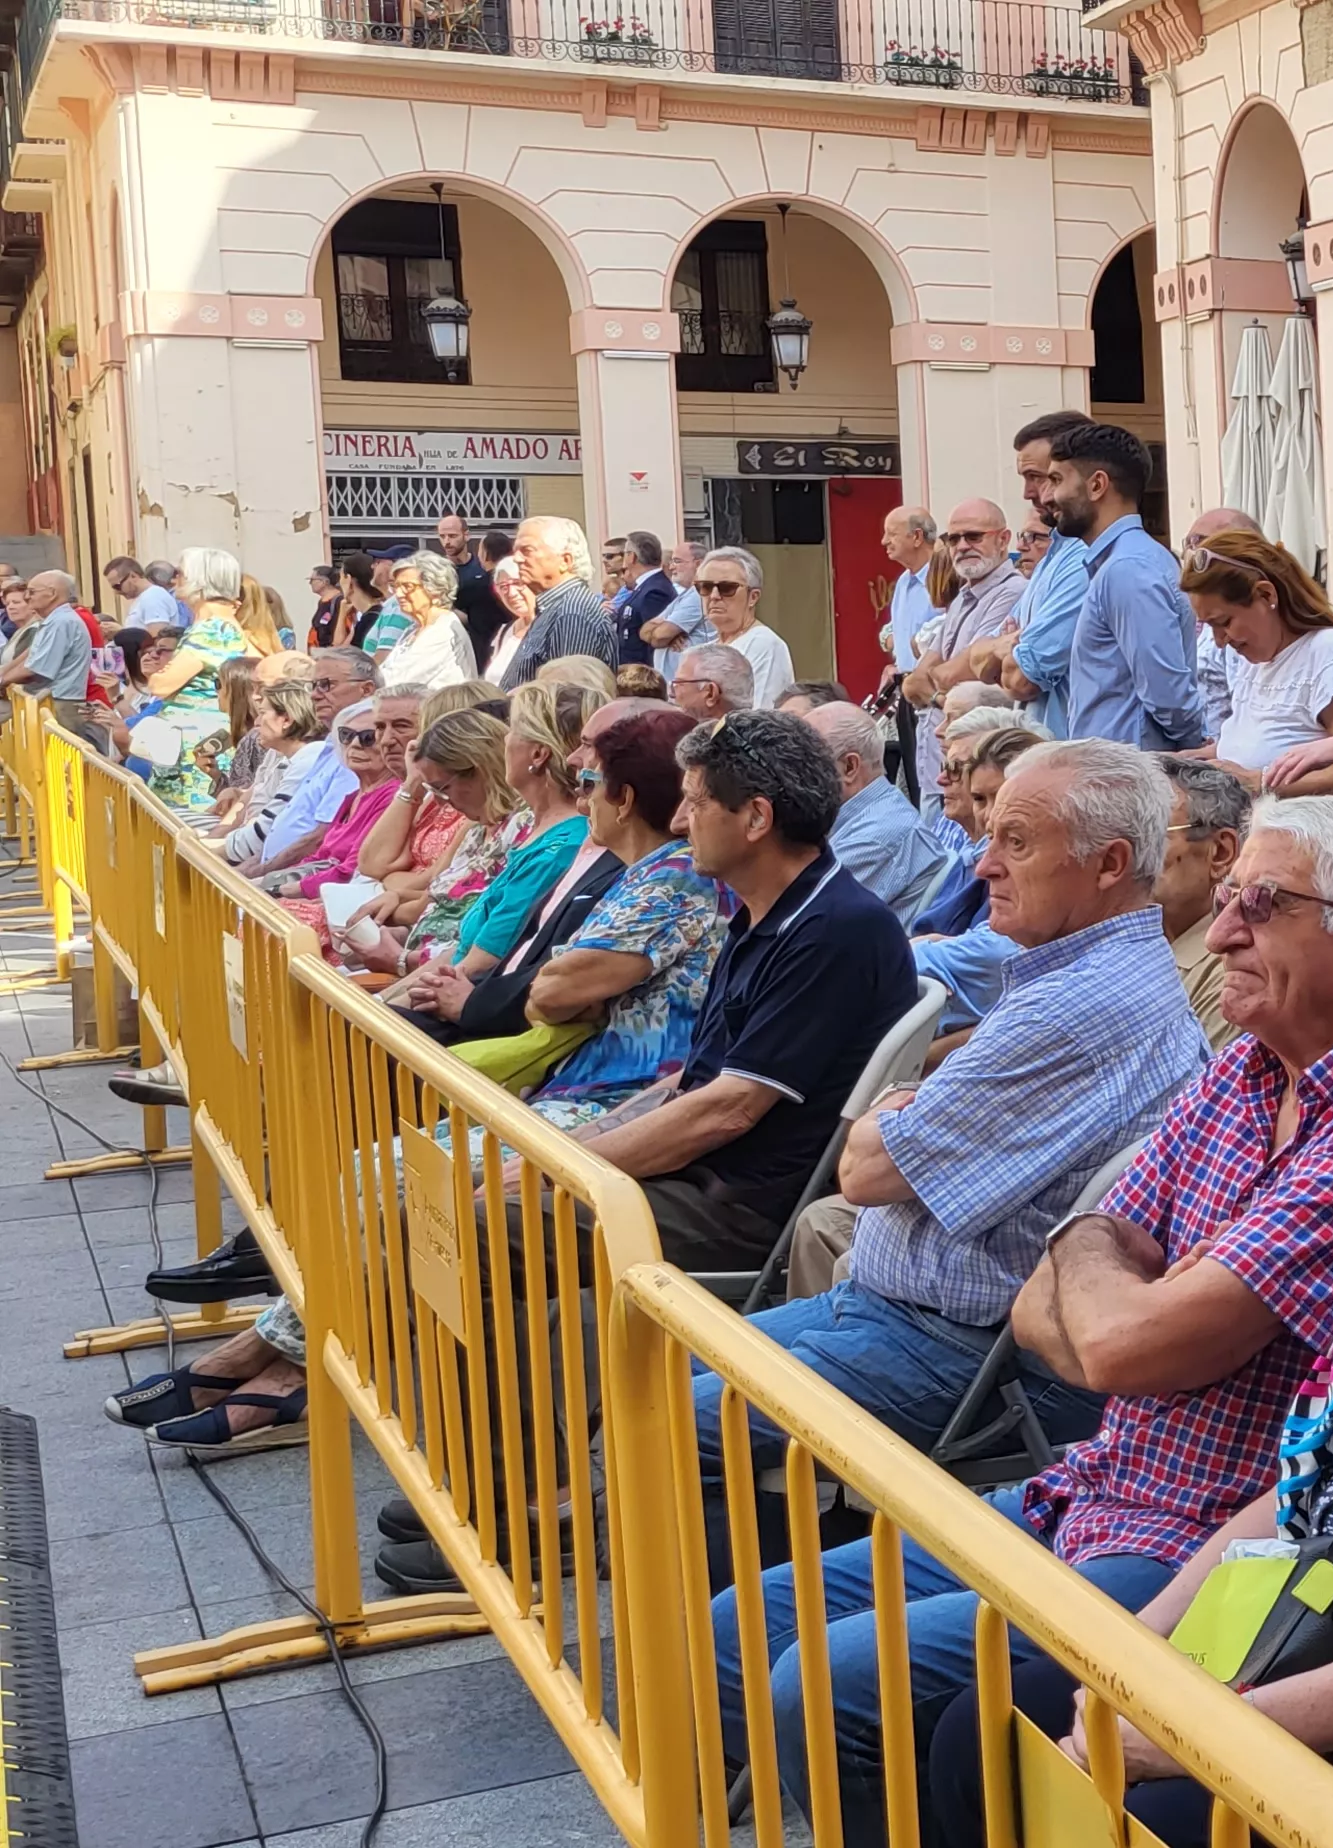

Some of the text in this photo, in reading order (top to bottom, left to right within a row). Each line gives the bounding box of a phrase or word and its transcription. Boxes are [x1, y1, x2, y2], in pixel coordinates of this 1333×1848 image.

[447, 450, 458, 459] DE
[463, 436, 549, 460] AMADO
[773, 446, 892, 470] El Rey
